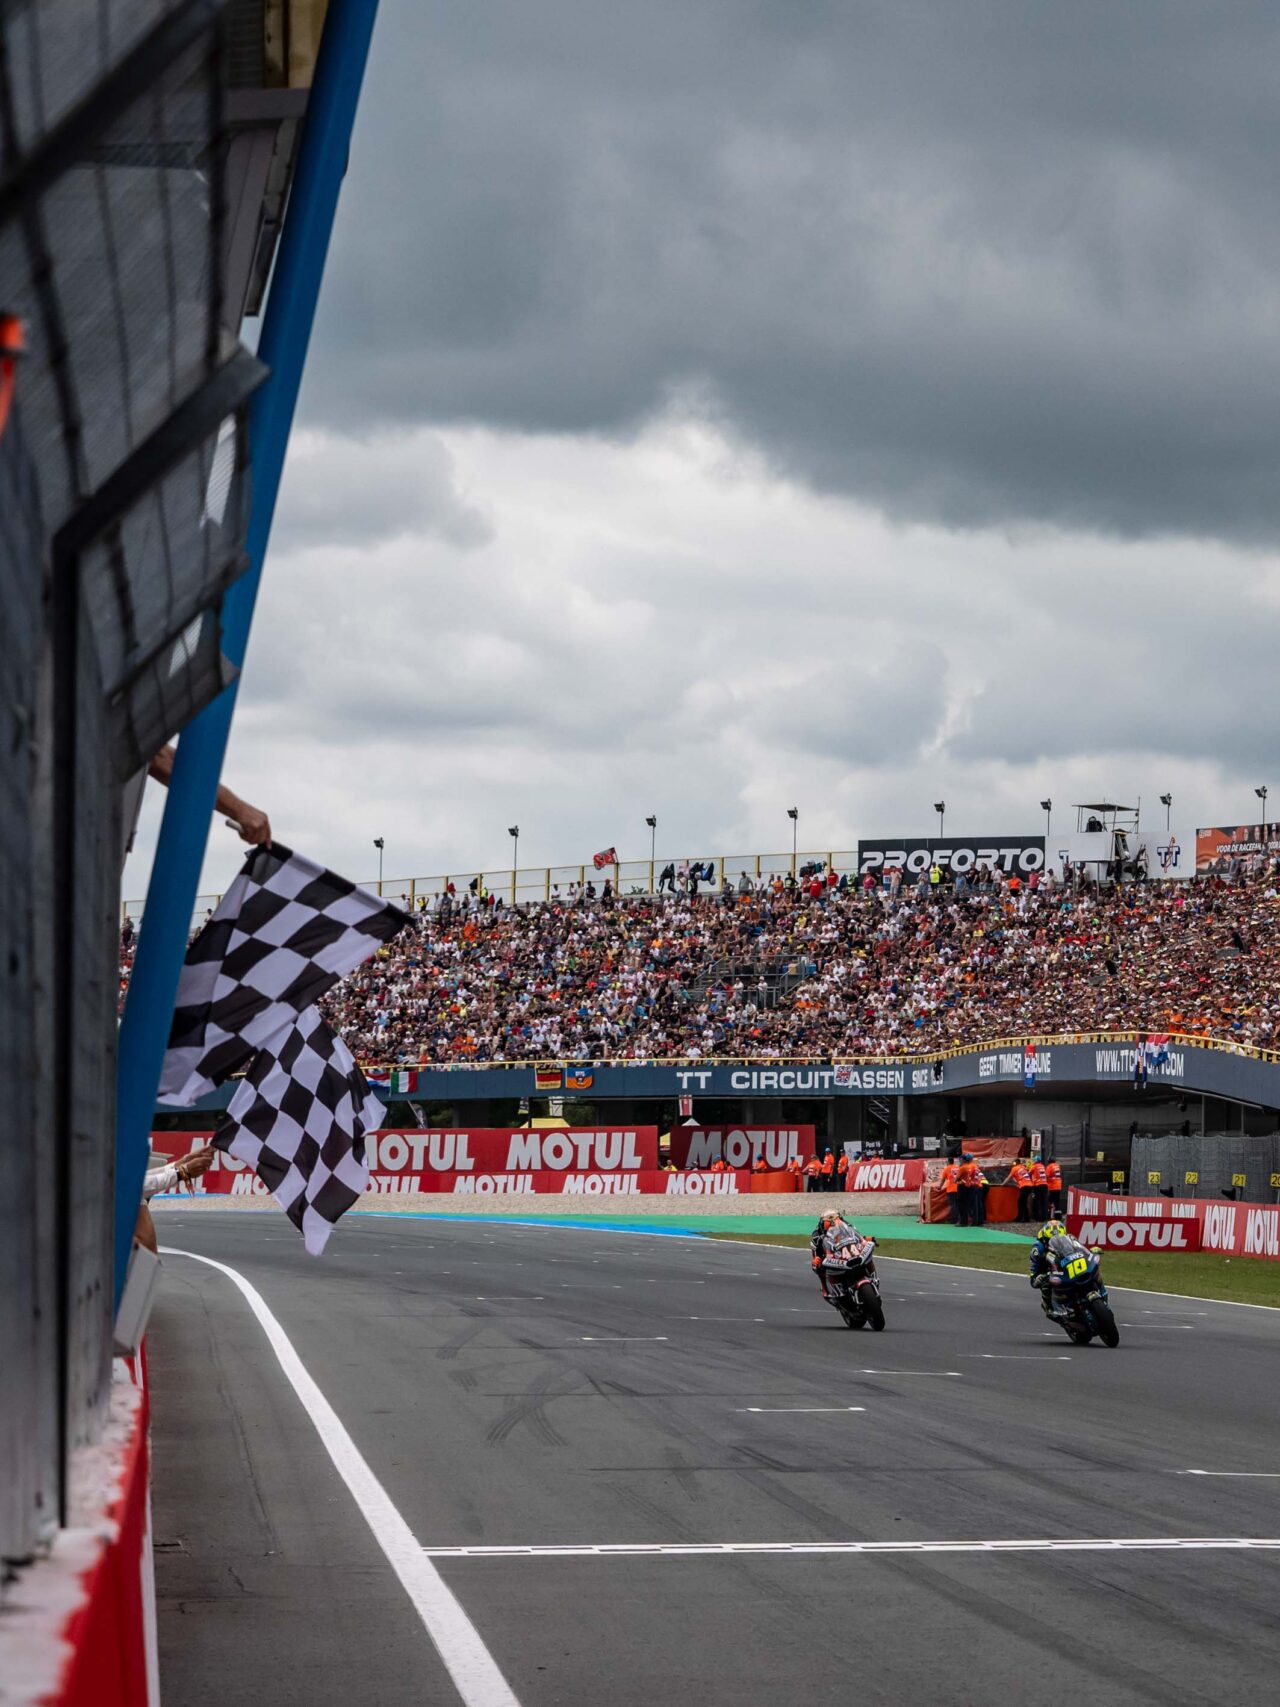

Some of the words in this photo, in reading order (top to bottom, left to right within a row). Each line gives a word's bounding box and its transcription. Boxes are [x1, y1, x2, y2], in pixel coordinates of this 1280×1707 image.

[860, 847, 1046, 874] PROFORTO
[979, 1055, 998, 1077] GEERT
[676, 1071, 712, 1089] TT
[731, 1071, 834, 1089] CIRCUIT
[848, 1071, 904, 1089] ASSEN
[912, 1069, 928, 1088] SINCE
[505, 1132, 642, 1171] MOTUL
[685, 1129, 804, 1169] MOTUL
[366, 1176, 424, 1194] OTUL
[453, 1175, 536, 1194] MOTUL
[561, 1175, 641, 1195] MOTUL
[666, 1174, 738, 1195] MOTUL
[853, 1164, 906, 1190] MOTUL
[1150, 1174, 1160, 1183] 23
[1186, 1173, 1197, 1182] 22
[1234, 1175, 1244, 1185] 21
[1078, 1220, 1188, 1248] MOTUL
[1203, 1205, 1236, 1250] MOTUL
[1245, 1209, 1279, 1256] MOTUL
[1066, 1257, 1088, 1279] 10
